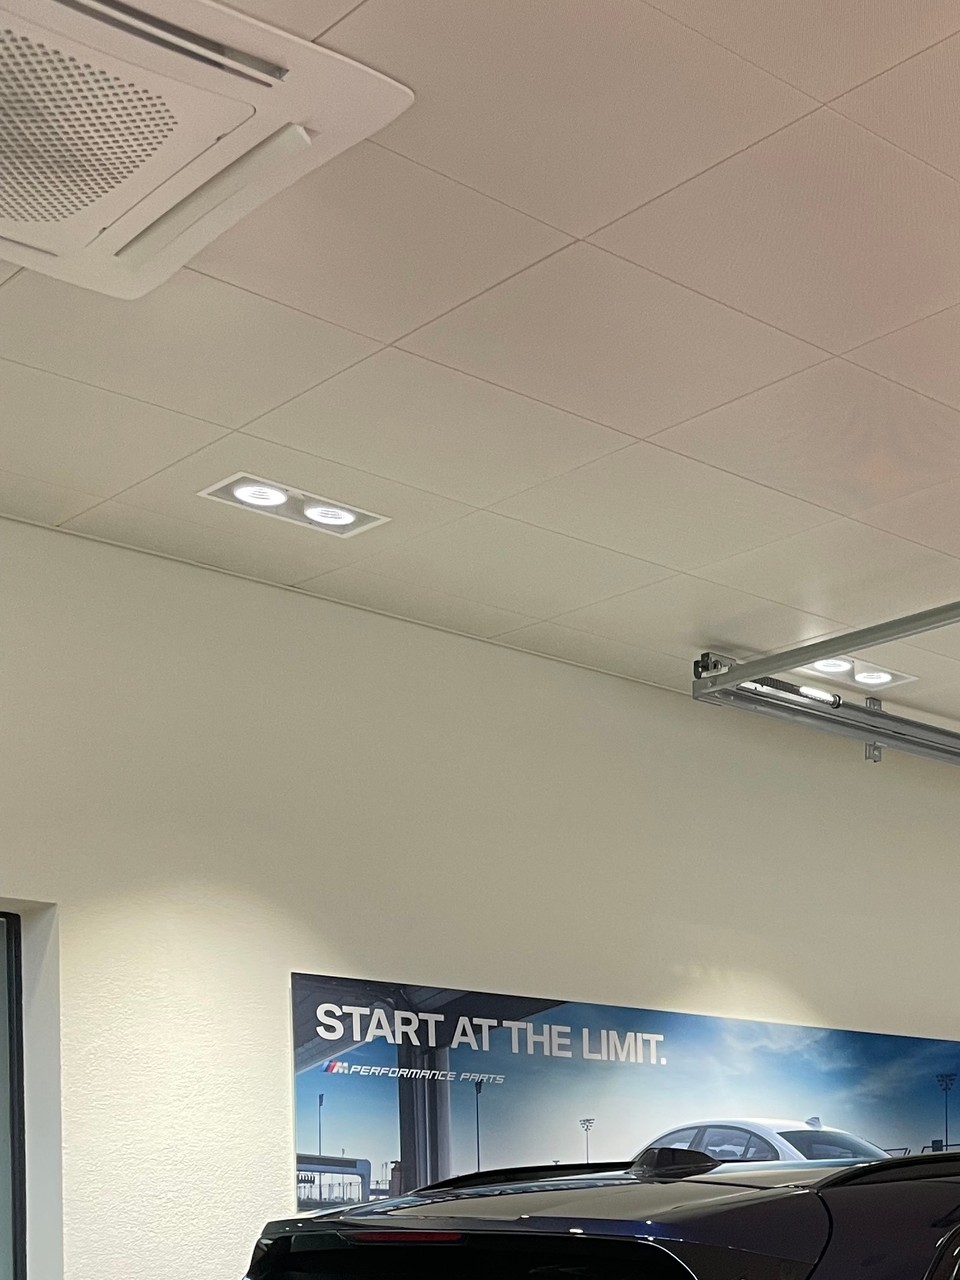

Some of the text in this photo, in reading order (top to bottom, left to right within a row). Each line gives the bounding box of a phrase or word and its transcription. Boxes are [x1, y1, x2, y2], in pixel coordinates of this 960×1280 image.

[316, 1003, 667, 1065] START AT THE LIMIT.
[350, 1065, 456, 1081] PERFORMANCE
[460, 1072, 505, 1084] PARTS
